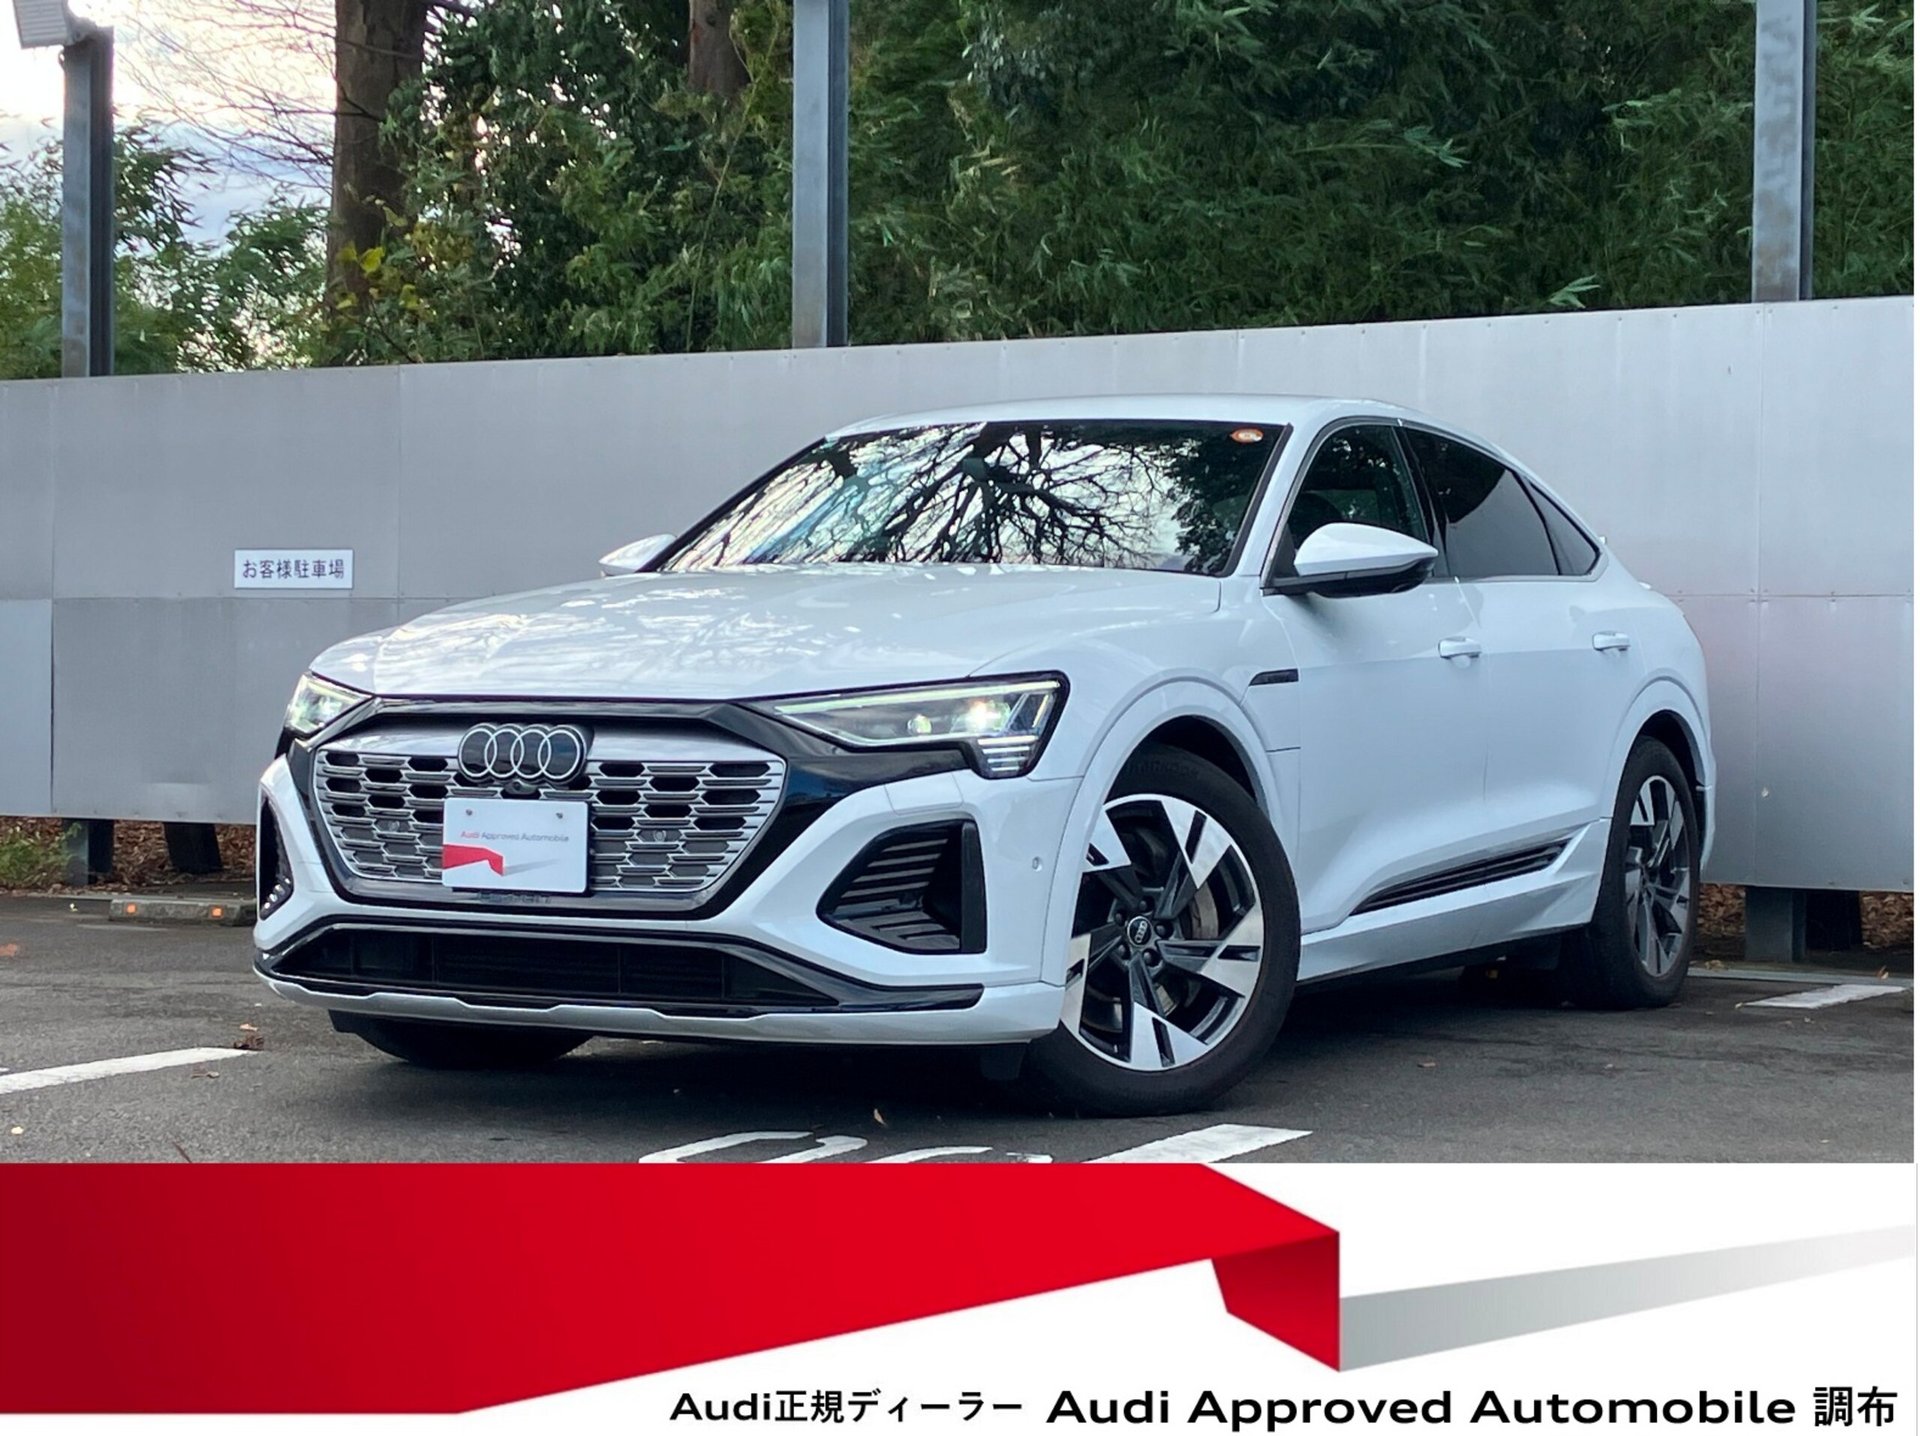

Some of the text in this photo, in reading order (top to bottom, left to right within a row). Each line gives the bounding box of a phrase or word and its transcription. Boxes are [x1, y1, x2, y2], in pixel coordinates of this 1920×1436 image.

[242, 558, 344, 579] お客様駐車場
[460, 830, 569, 843] Audi Approved Automobile
